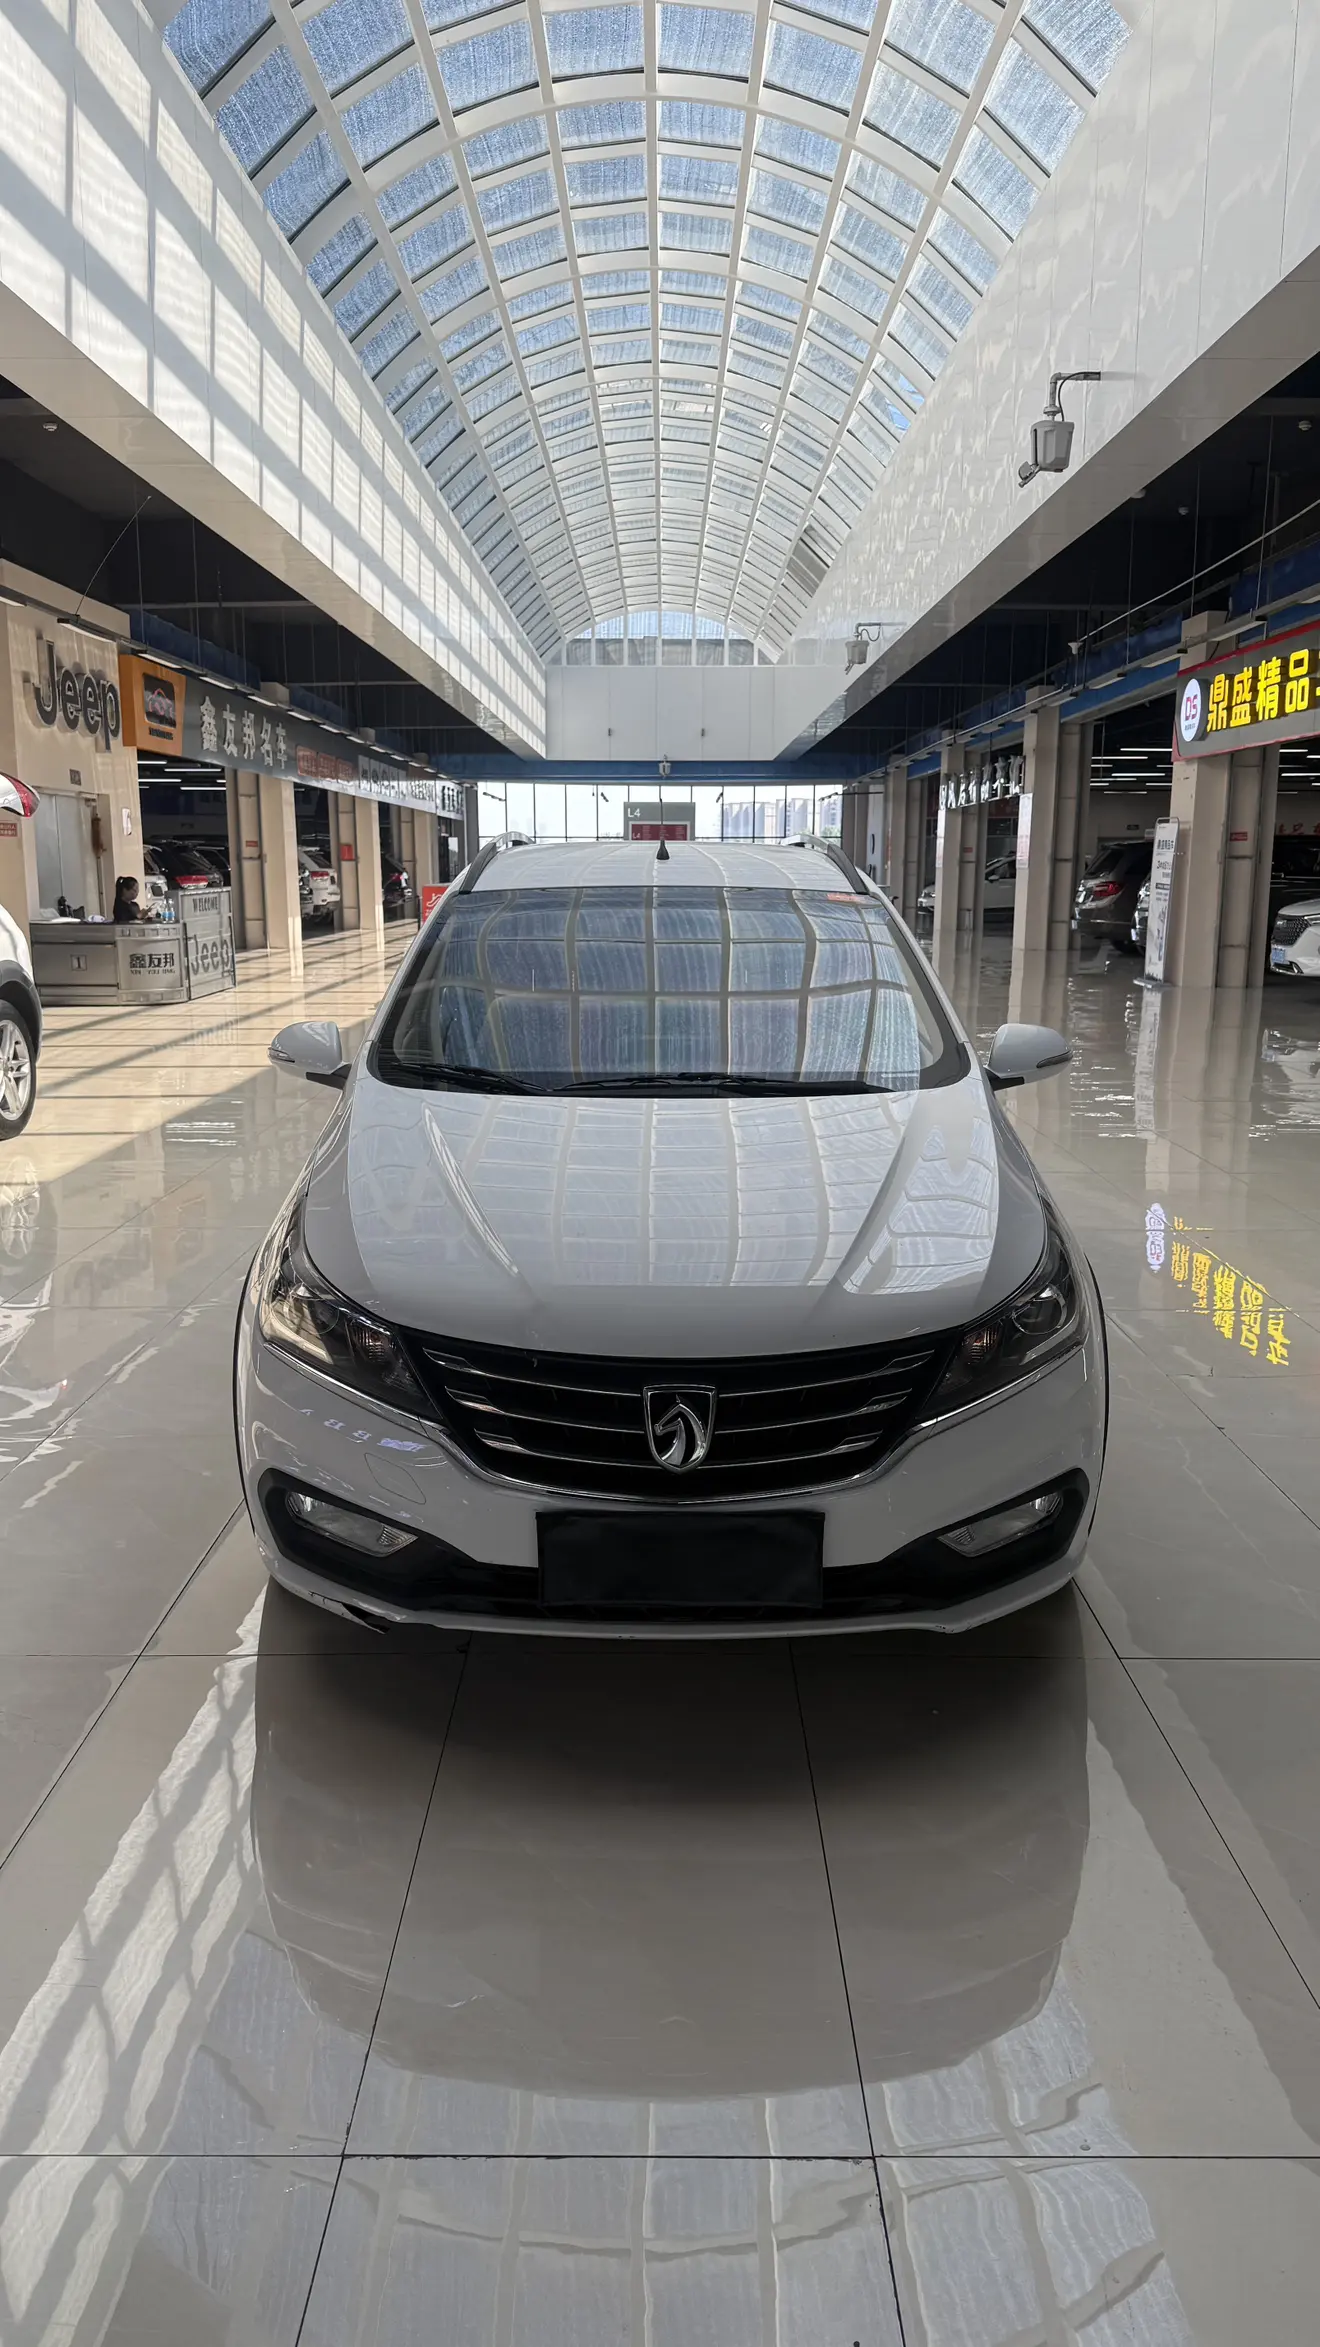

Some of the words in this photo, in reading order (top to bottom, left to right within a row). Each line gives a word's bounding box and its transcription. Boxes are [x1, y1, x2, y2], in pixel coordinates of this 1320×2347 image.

[26, 638, 123, 753] Jeep
[1206, 648, 1320, 733] 鼎盛精品
[1184, 693, 1198, 721] DS
[627, 807, 641, 818] L4
[192, 896, 219, 913] WELCOME
[129, 952, 175, 969] 鑫友邦
[191, 934, 230, 977] Jeep
